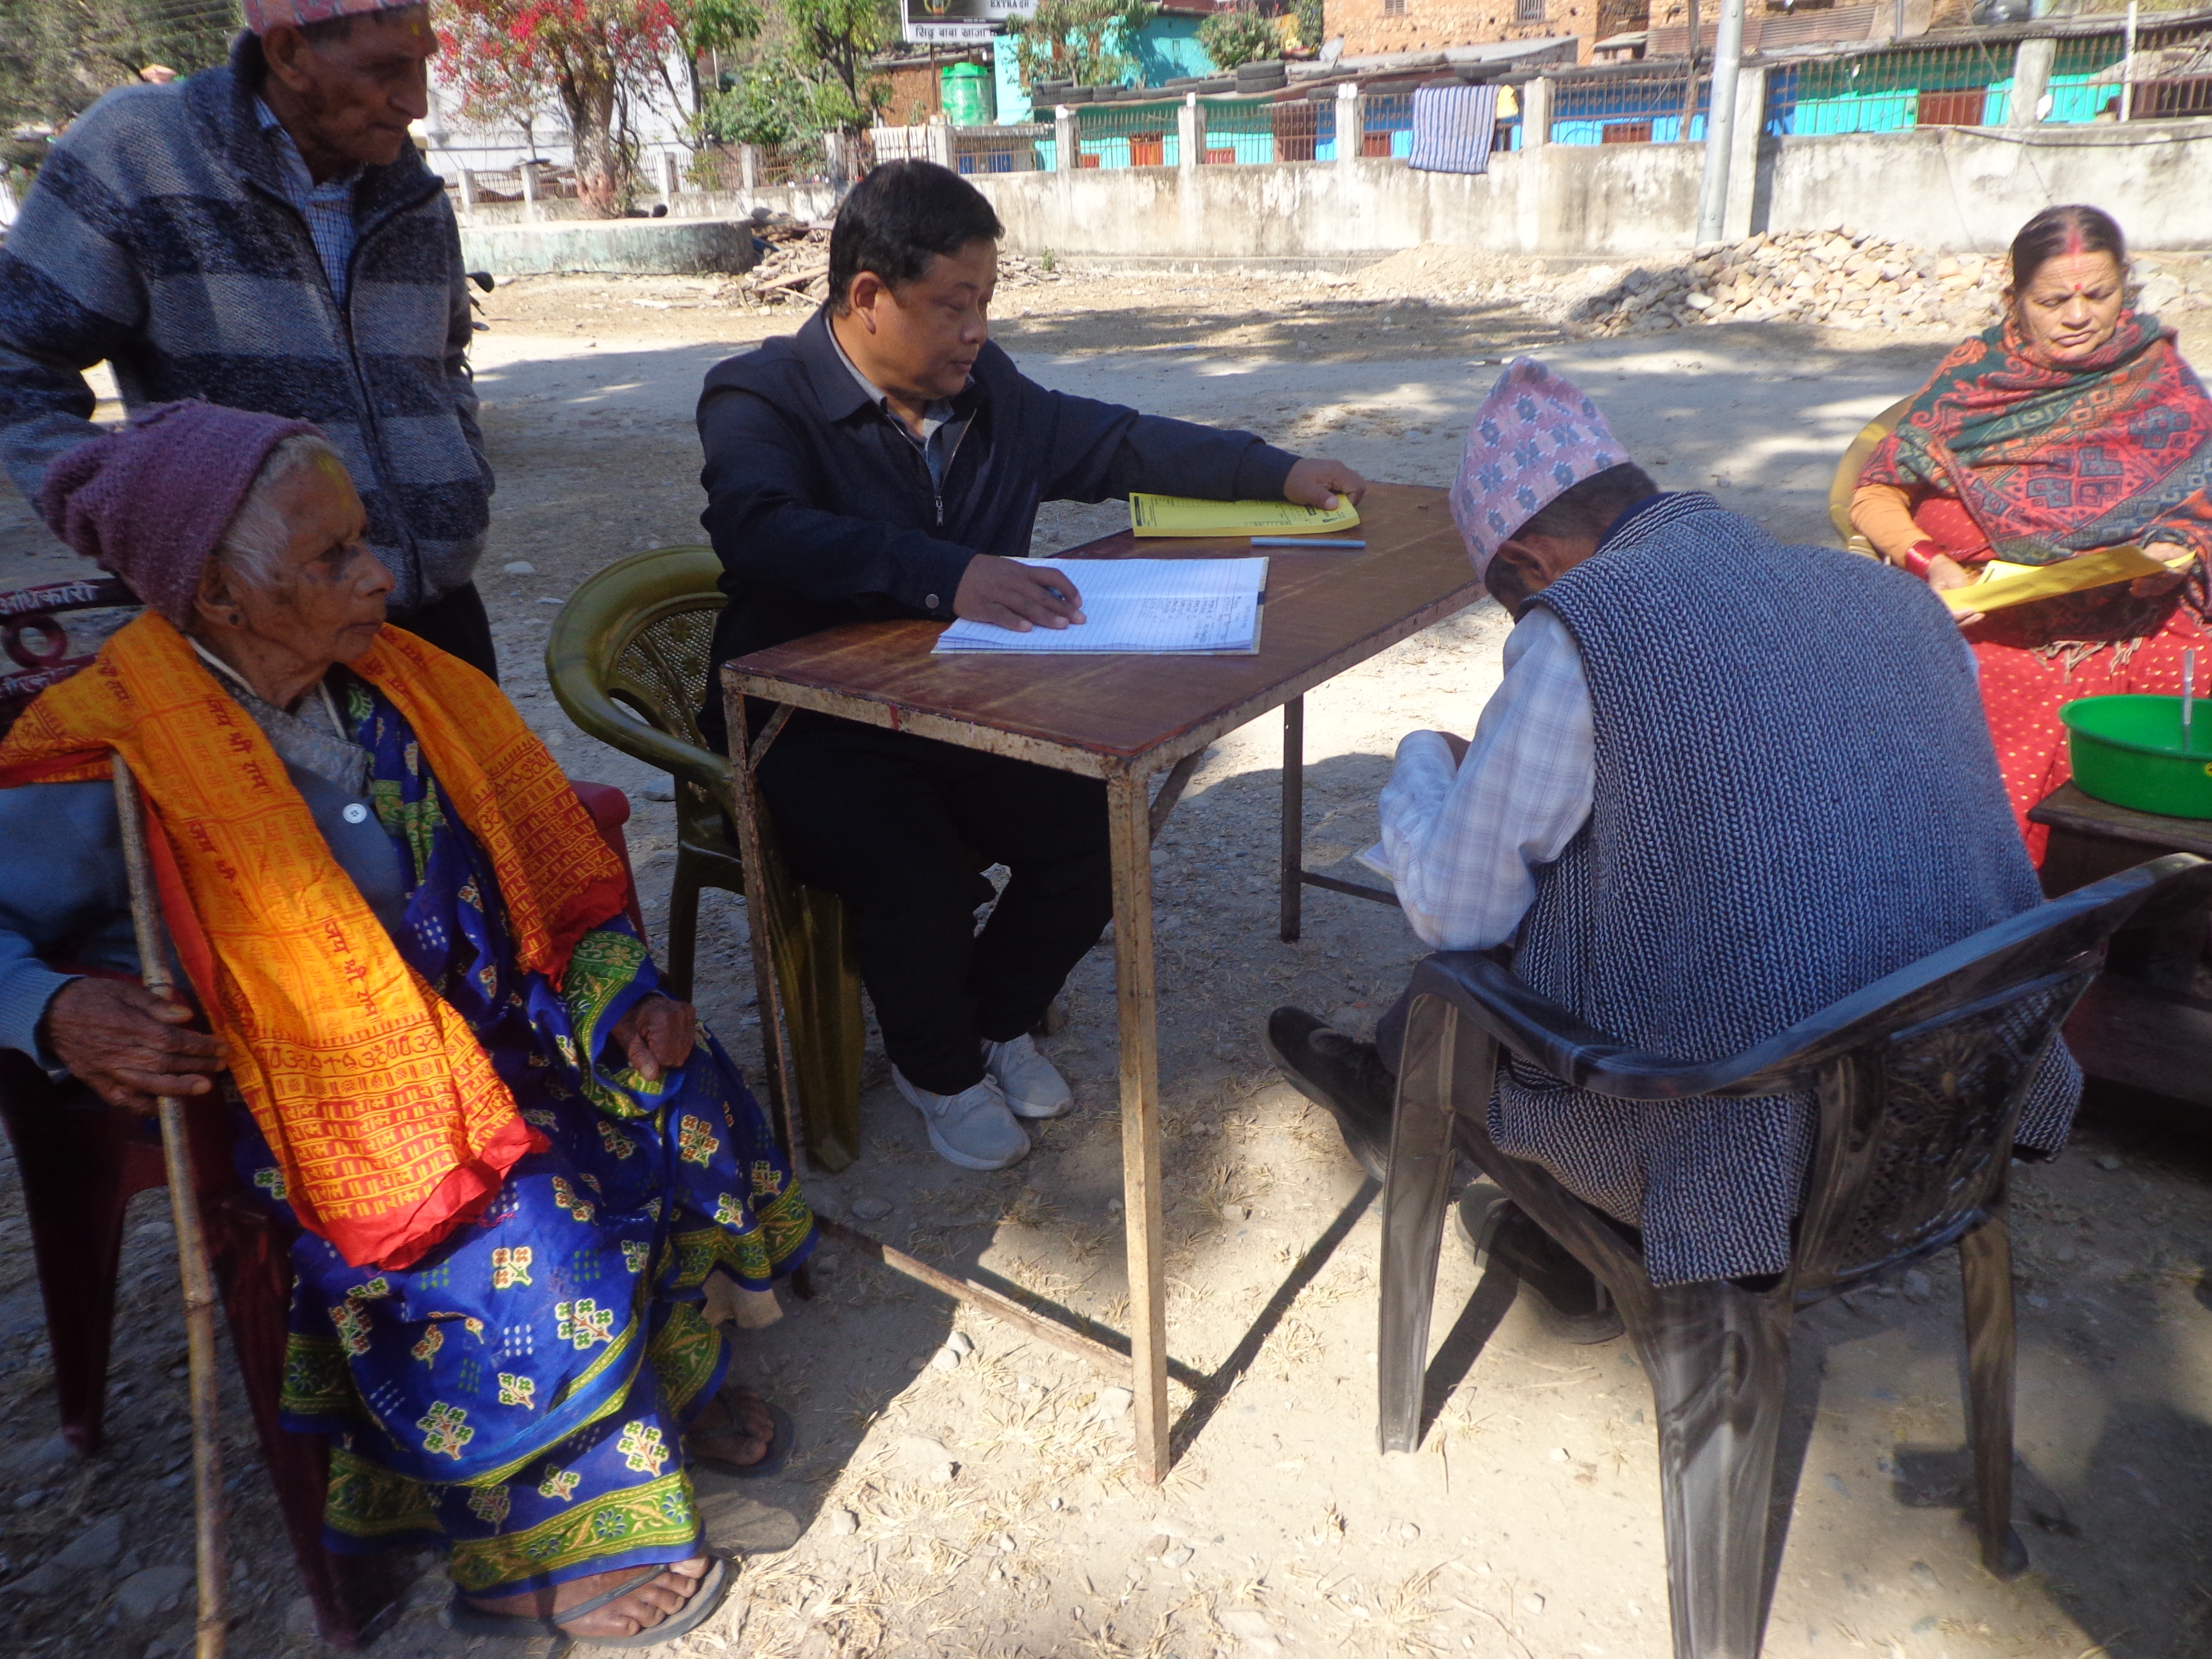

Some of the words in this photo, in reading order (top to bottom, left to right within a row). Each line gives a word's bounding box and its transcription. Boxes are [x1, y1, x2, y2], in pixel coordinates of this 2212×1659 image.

[938, 28, 957, 37] बाबा
[961, 28, 986, 37] खाजा
[325, 921, 350, 953] जय
[344, 959, 366, 986] श्री
[357, 989, 378, 1017] राम
